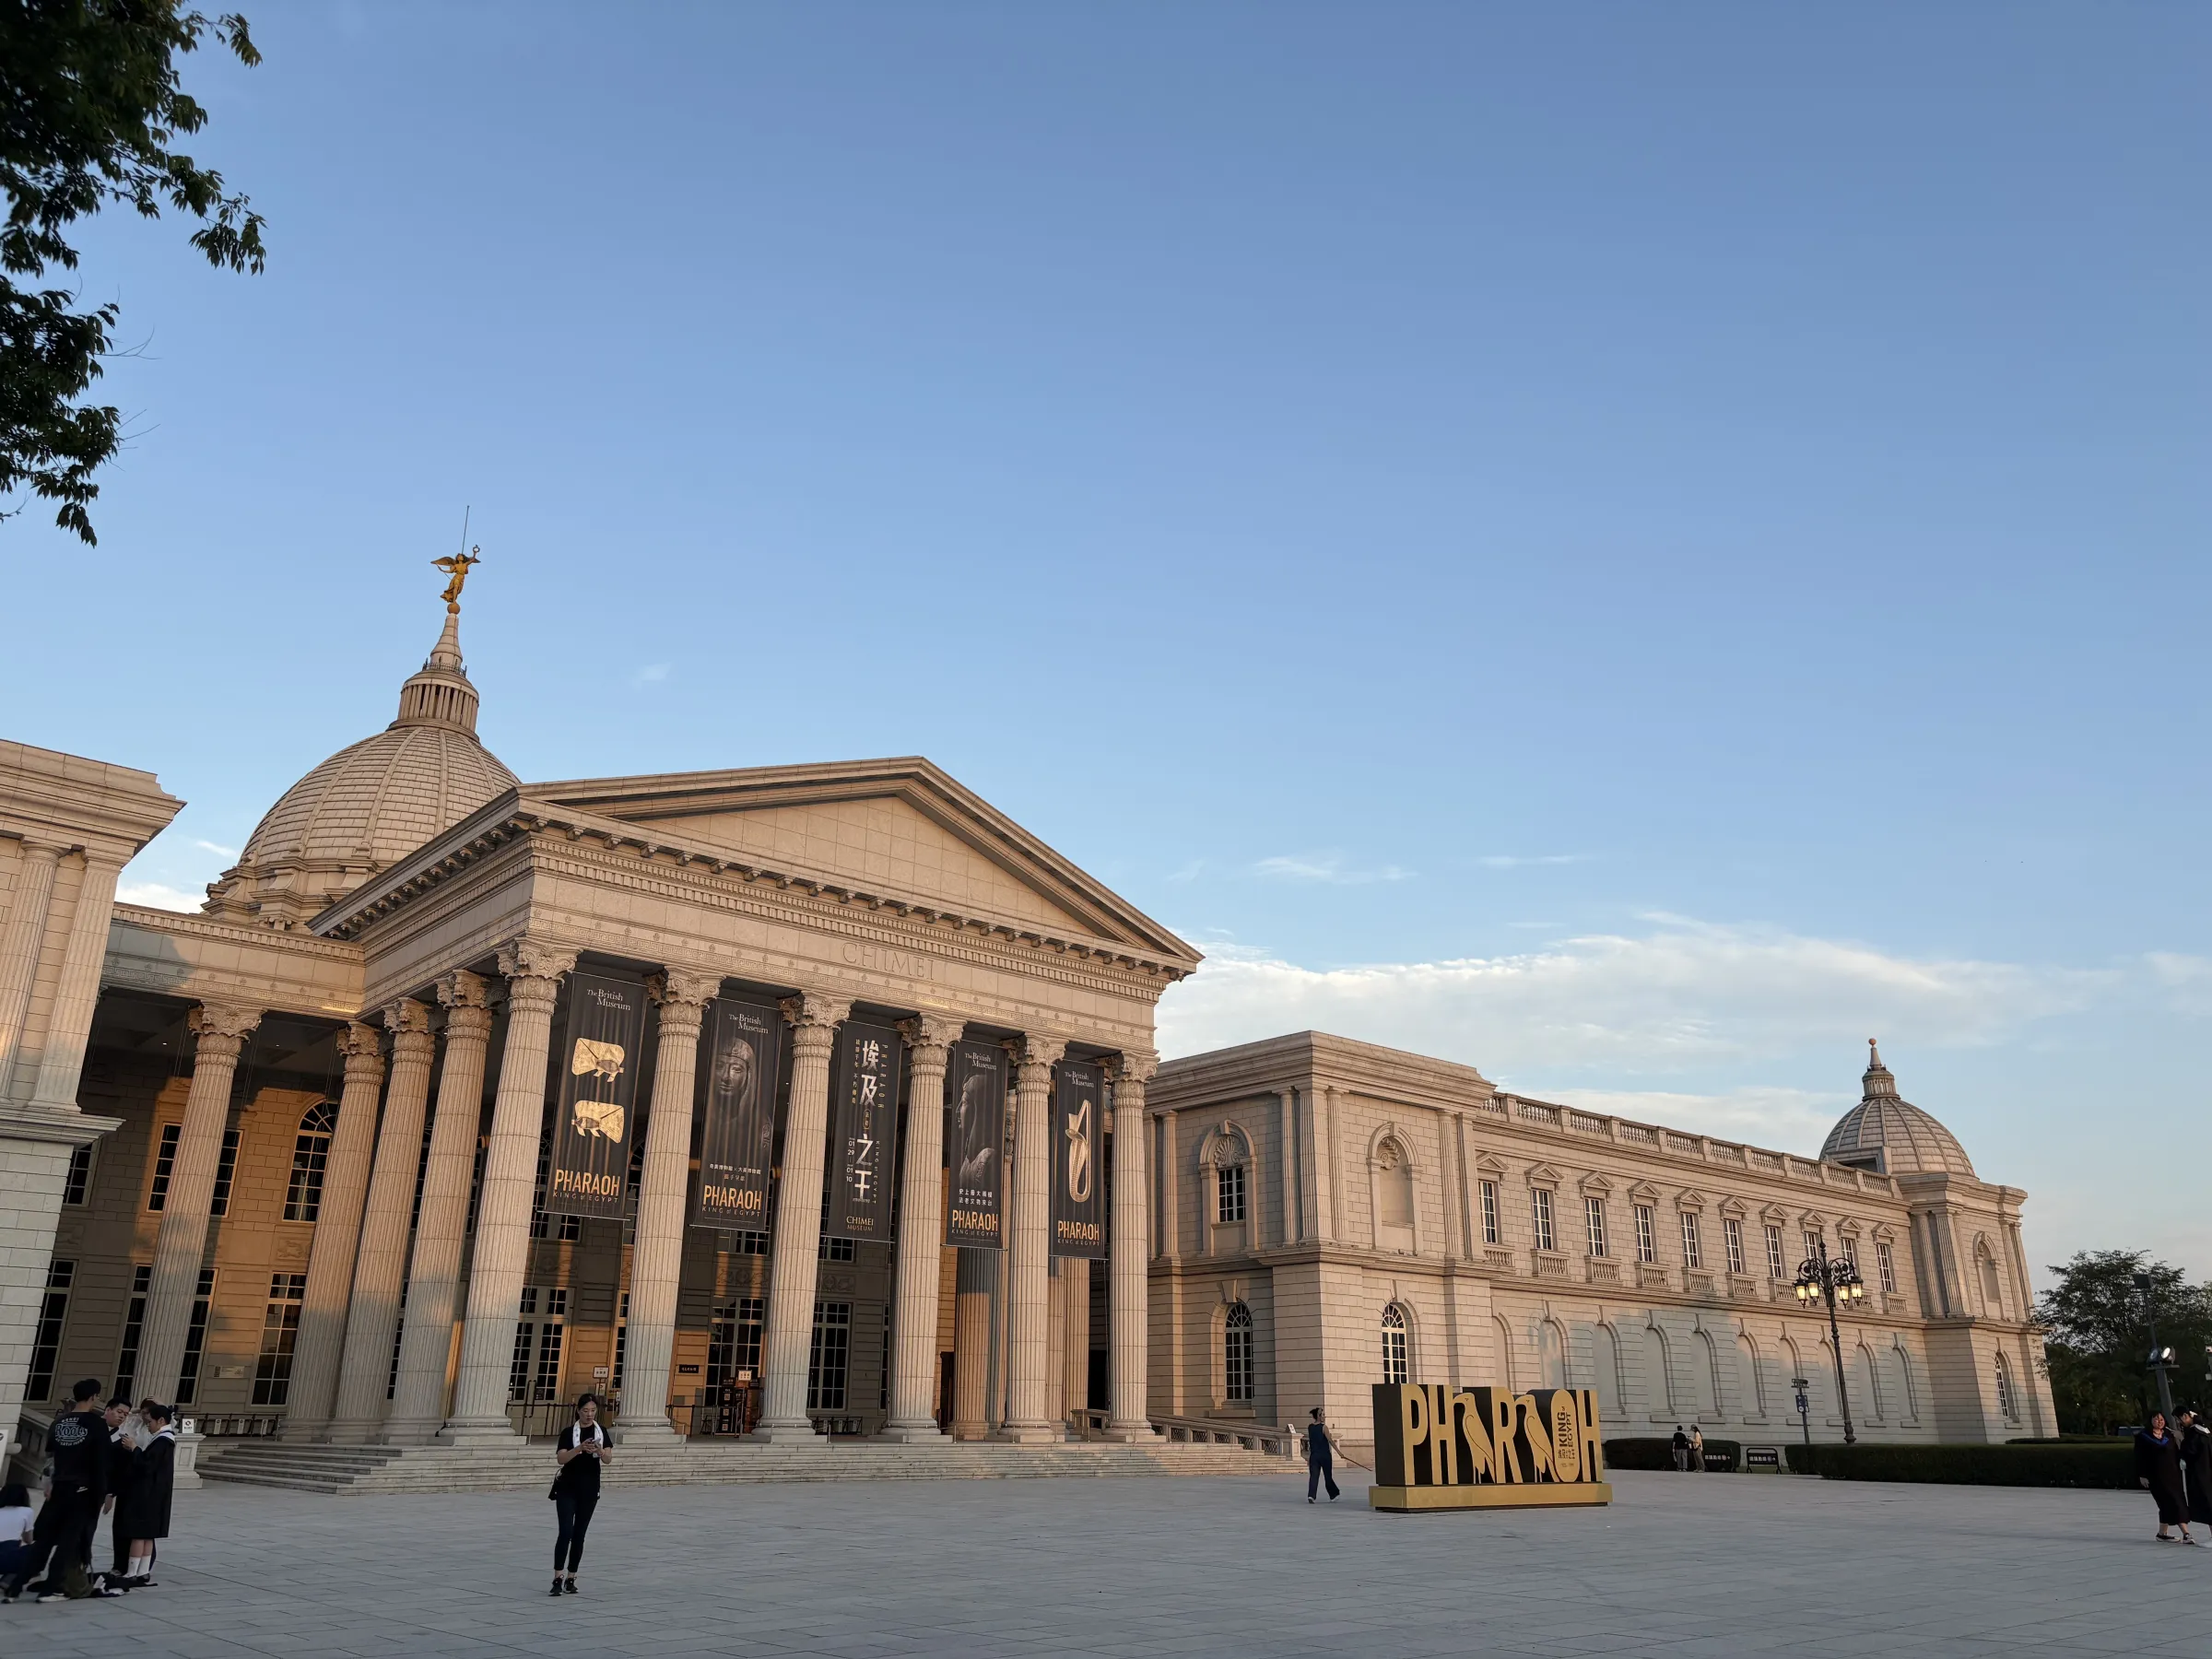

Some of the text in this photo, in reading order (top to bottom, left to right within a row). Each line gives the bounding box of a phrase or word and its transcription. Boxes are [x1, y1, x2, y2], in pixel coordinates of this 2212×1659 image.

[598, 989, 623, 1002] British
[597, 997, 630, 1011] Museum
[739, 1014, 761, 1025] British
[738, 1021, 769, 1034] Museum
[972, 1052, 991, 1063] British
[972, 1060, 997, 1071] Museum
[860, 1040, 879, 1107] 埃及
[877, 1044, 888, 1109] PHARAOH
[1072, 1070, 1089, 1080] British
[1072, 1077, 1094, 1088] Museum
[554, 1169, 620, 1197] PHARAOH
[553, 1191, 578, 1199] KING
[588, 1194, 619, 1203] EGYPT
[702, 1184, 763, 1210] PHARAOH
[701, 1206, 724, 1214] KING
[734, 1209, 761, 1218] EGYPT
[846, 1216, 875, 1226] CHIMEI
[952, 1209, 999, 1231] PHARAOH
[847, 1224, 874, 1232] MUSEUM
[1057, 1219, 1100, 1241] PHARAOH
[1557, 1411, 1568, 1448] KING
